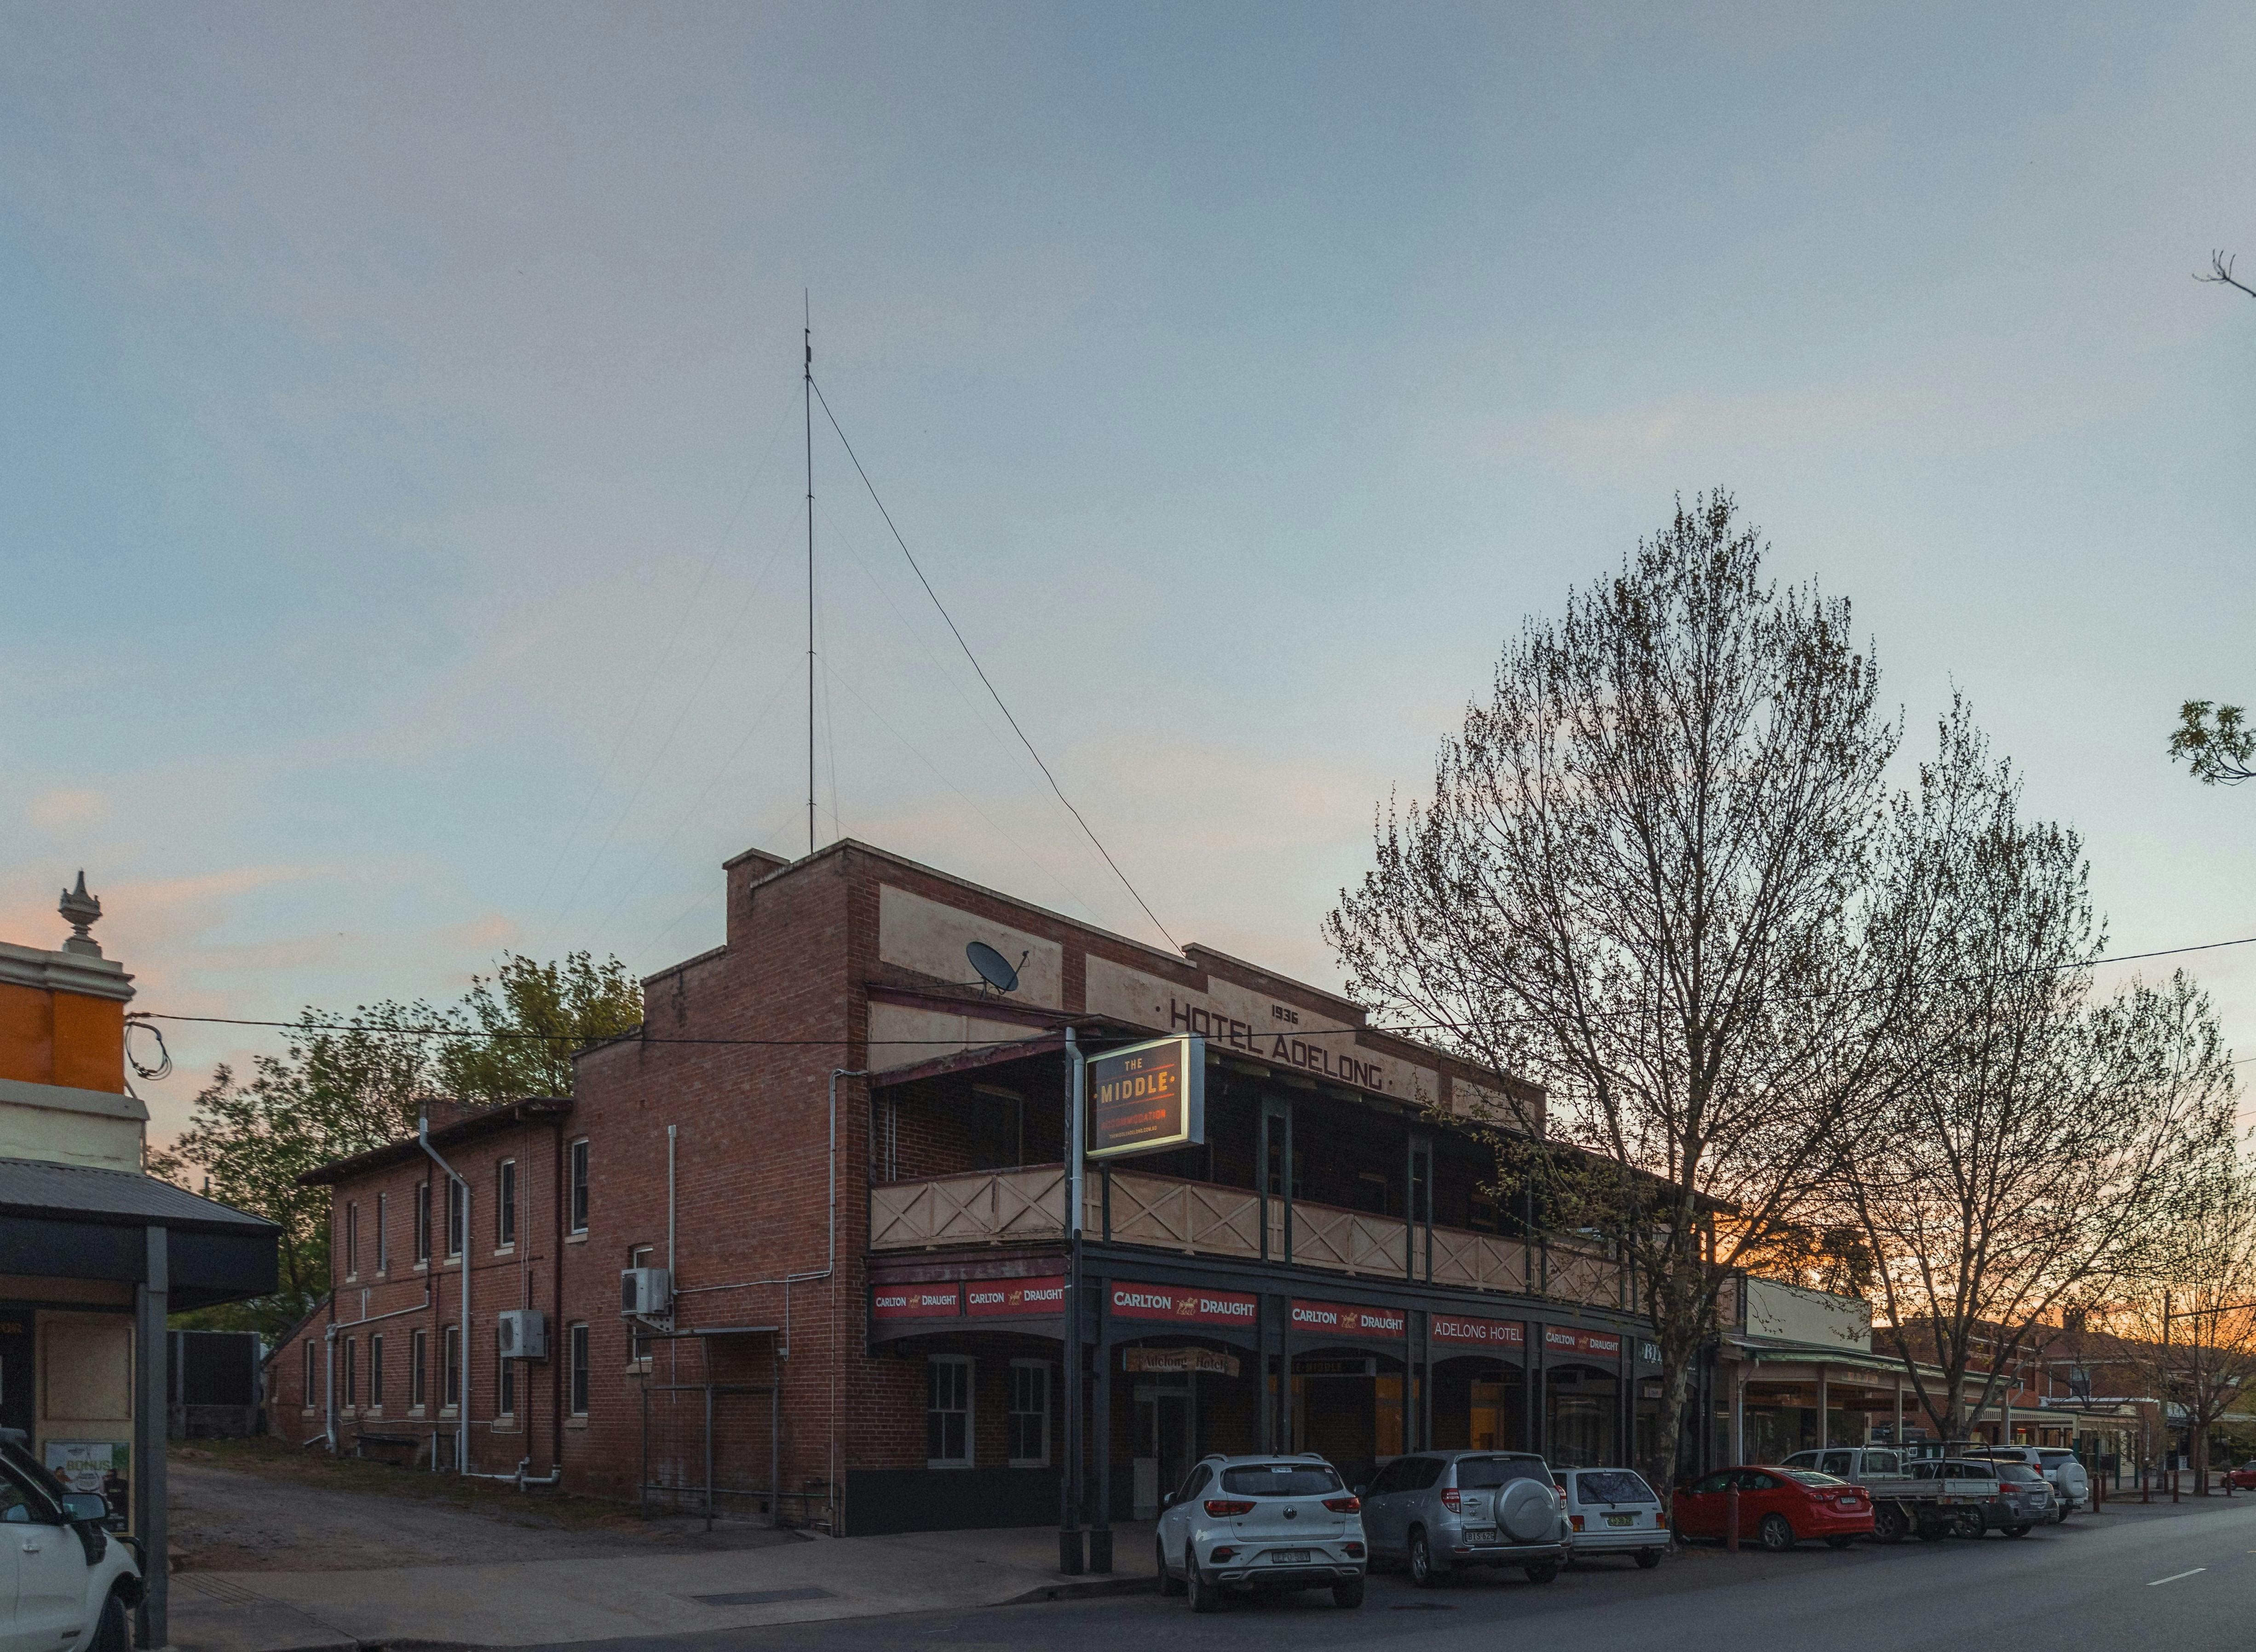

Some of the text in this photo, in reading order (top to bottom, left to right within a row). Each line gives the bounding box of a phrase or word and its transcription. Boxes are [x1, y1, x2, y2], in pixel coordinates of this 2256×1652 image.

[1272, 1004, 1299, 1024] 1936
[1171, 998, 1382, 1090] HOTEL ADELONG
[1124, 1058, 1142, 1071] THE
[1100, 1071, 1168, 1104] MIDDLE
[875, 1295, 956, 1307] CARLTON DRAUGHT
[969, 1289, 1063, 1304] CARLTON DRAUGHT
[1114, 1291, 1255, 1317] CARLTON DRAUGHT
[1292, 1308, 1403, 1331] CARLTON DRAUGHT
[1434, 1322, 1523, 1342] ADELONG HOTEL
[1546, 1331, 1619, 1352] CARLTON DRAUGHT
[1144, 1355, 1223, 1370] Adelong Hotel
[66, 1460, 110, 1470] BONUS
